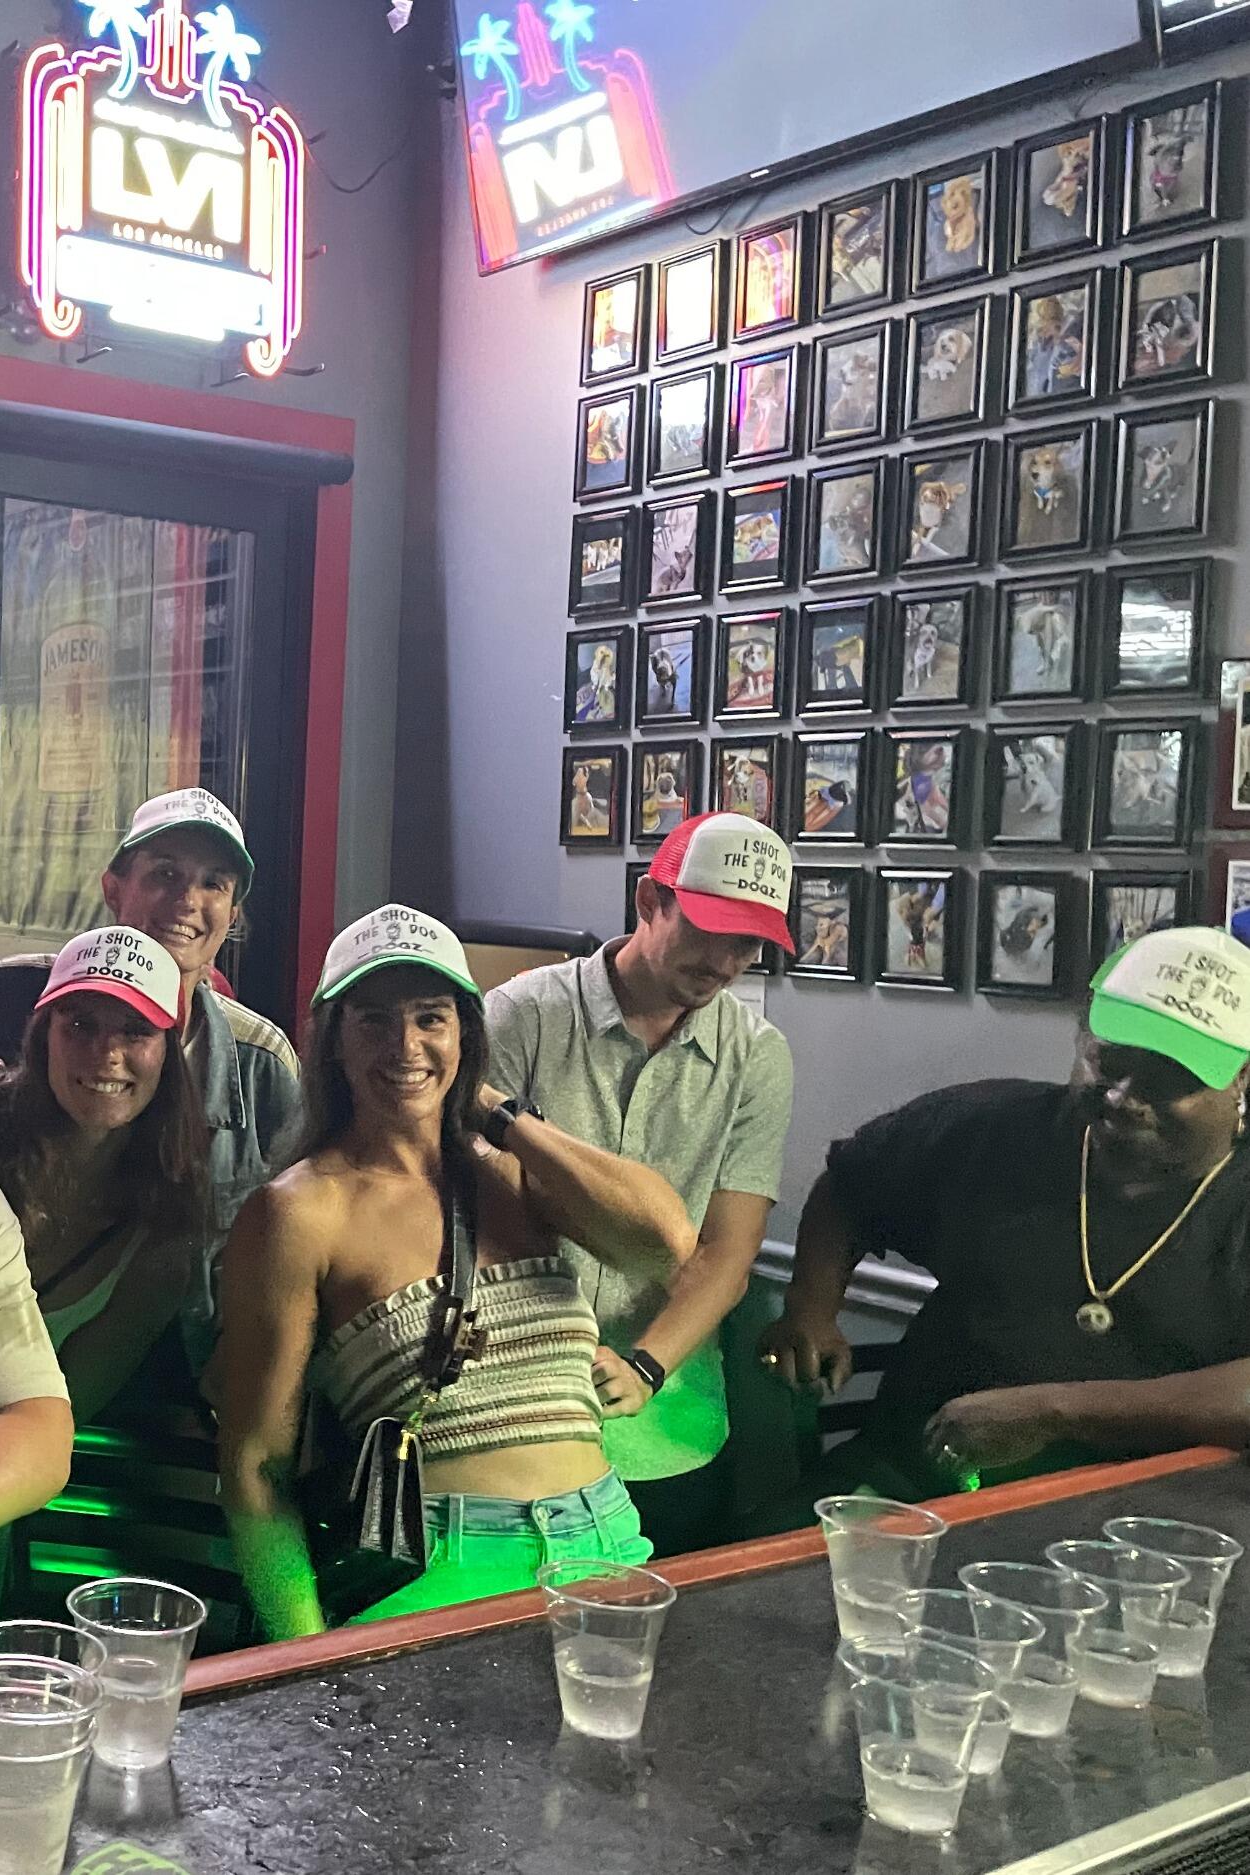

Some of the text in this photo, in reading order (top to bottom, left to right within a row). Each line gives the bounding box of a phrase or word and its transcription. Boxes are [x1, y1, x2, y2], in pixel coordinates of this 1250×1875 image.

[112, 222, 224, 263] LOS ANGELES
[752, 840, 780, 861] SHOT
[724, 853, 750, 867] THE
[737, 879, 776, 899] DOGZ
[380, 909, 419, 923] SHOT
[105, 933, 143, 950] SHOT
[353, 924, 438, 945] THE DOG
[371, 942, 423, 954] DOGZ
[76, 946, 154, 972] THE DOG
[86, 966, 136, 982] DOGZ
